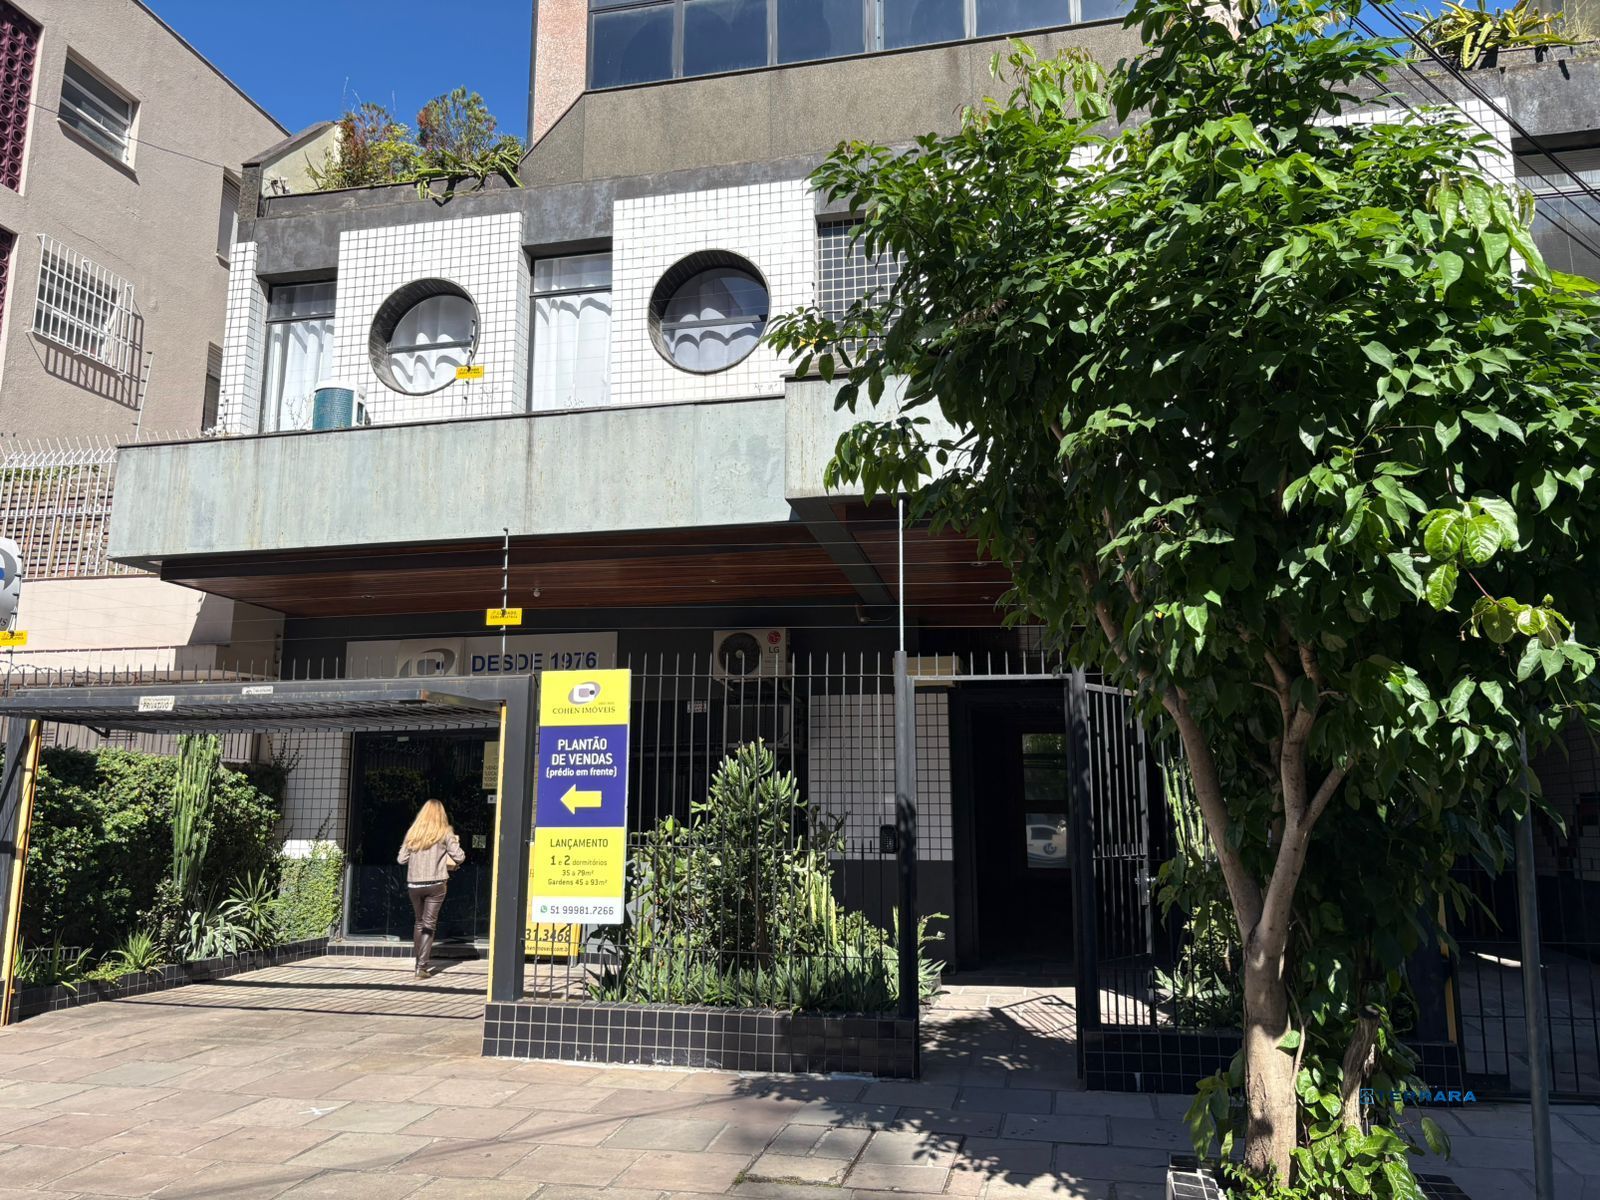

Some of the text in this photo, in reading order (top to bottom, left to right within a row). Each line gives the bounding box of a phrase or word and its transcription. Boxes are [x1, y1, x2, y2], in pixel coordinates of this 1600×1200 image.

[472, 651, 597, 672] DESDE 1976
[552, 705, 616, 715] COHEN IMÓVEIS
[557, 736, 608, 751] PLANTÃO
[551, 753, 613, 765] DE VENDAS
[550, 838, 609, 851] LANÇAMENTO
[550, 855, 557, 866] 1
[564, 855, 571, 866] 2
[572, 858, 608, 866] dormitórios
[562, 869, 571, 877] 35
[547, 878, 574, 886] Gardens
[575, 878, 583, 886] 45
[550, 906, 614, 916] 51 99981.7266
